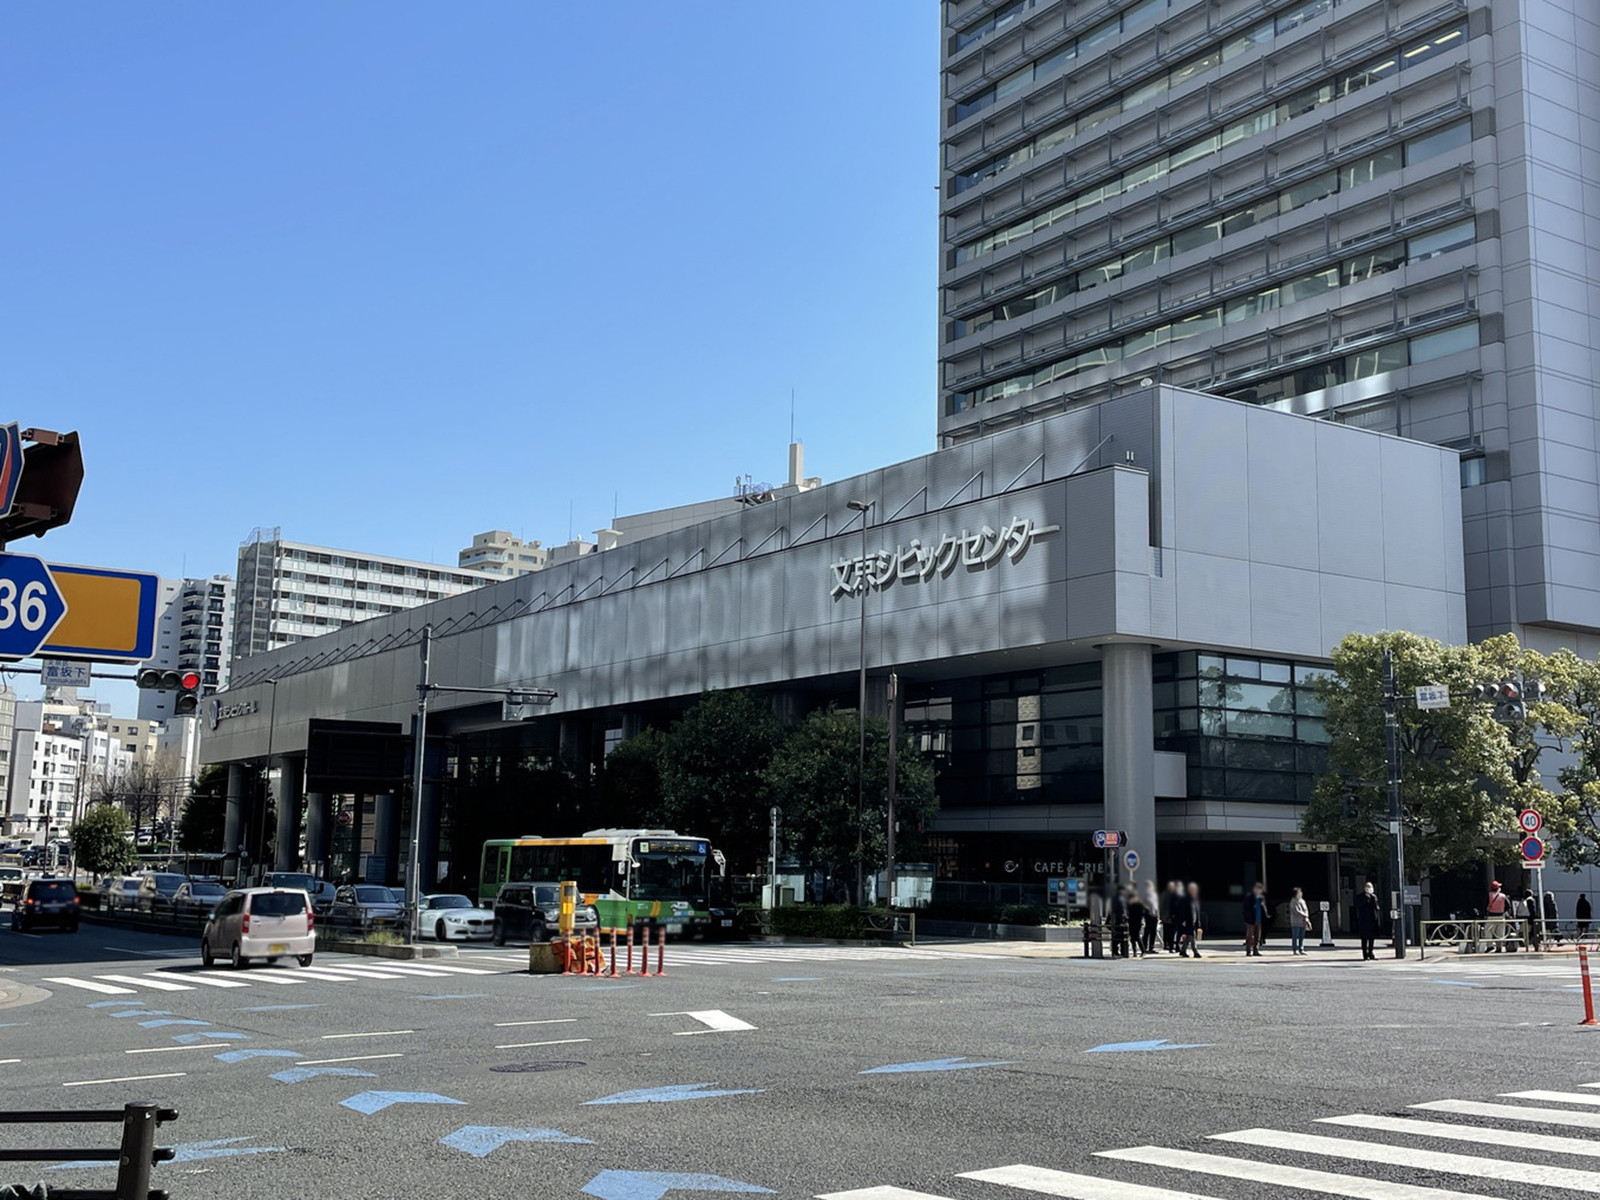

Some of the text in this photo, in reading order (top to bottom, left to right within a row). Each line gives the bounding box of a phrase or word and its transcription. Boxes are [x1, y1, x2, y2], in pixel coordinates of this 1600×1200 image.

[830, 515, 1060, 597] 文京シビックセンター
[0, 578, 47, 632] 36
[47, 665, 86, 678] 富坂下
[1524, 815, 1537, 827] 40
